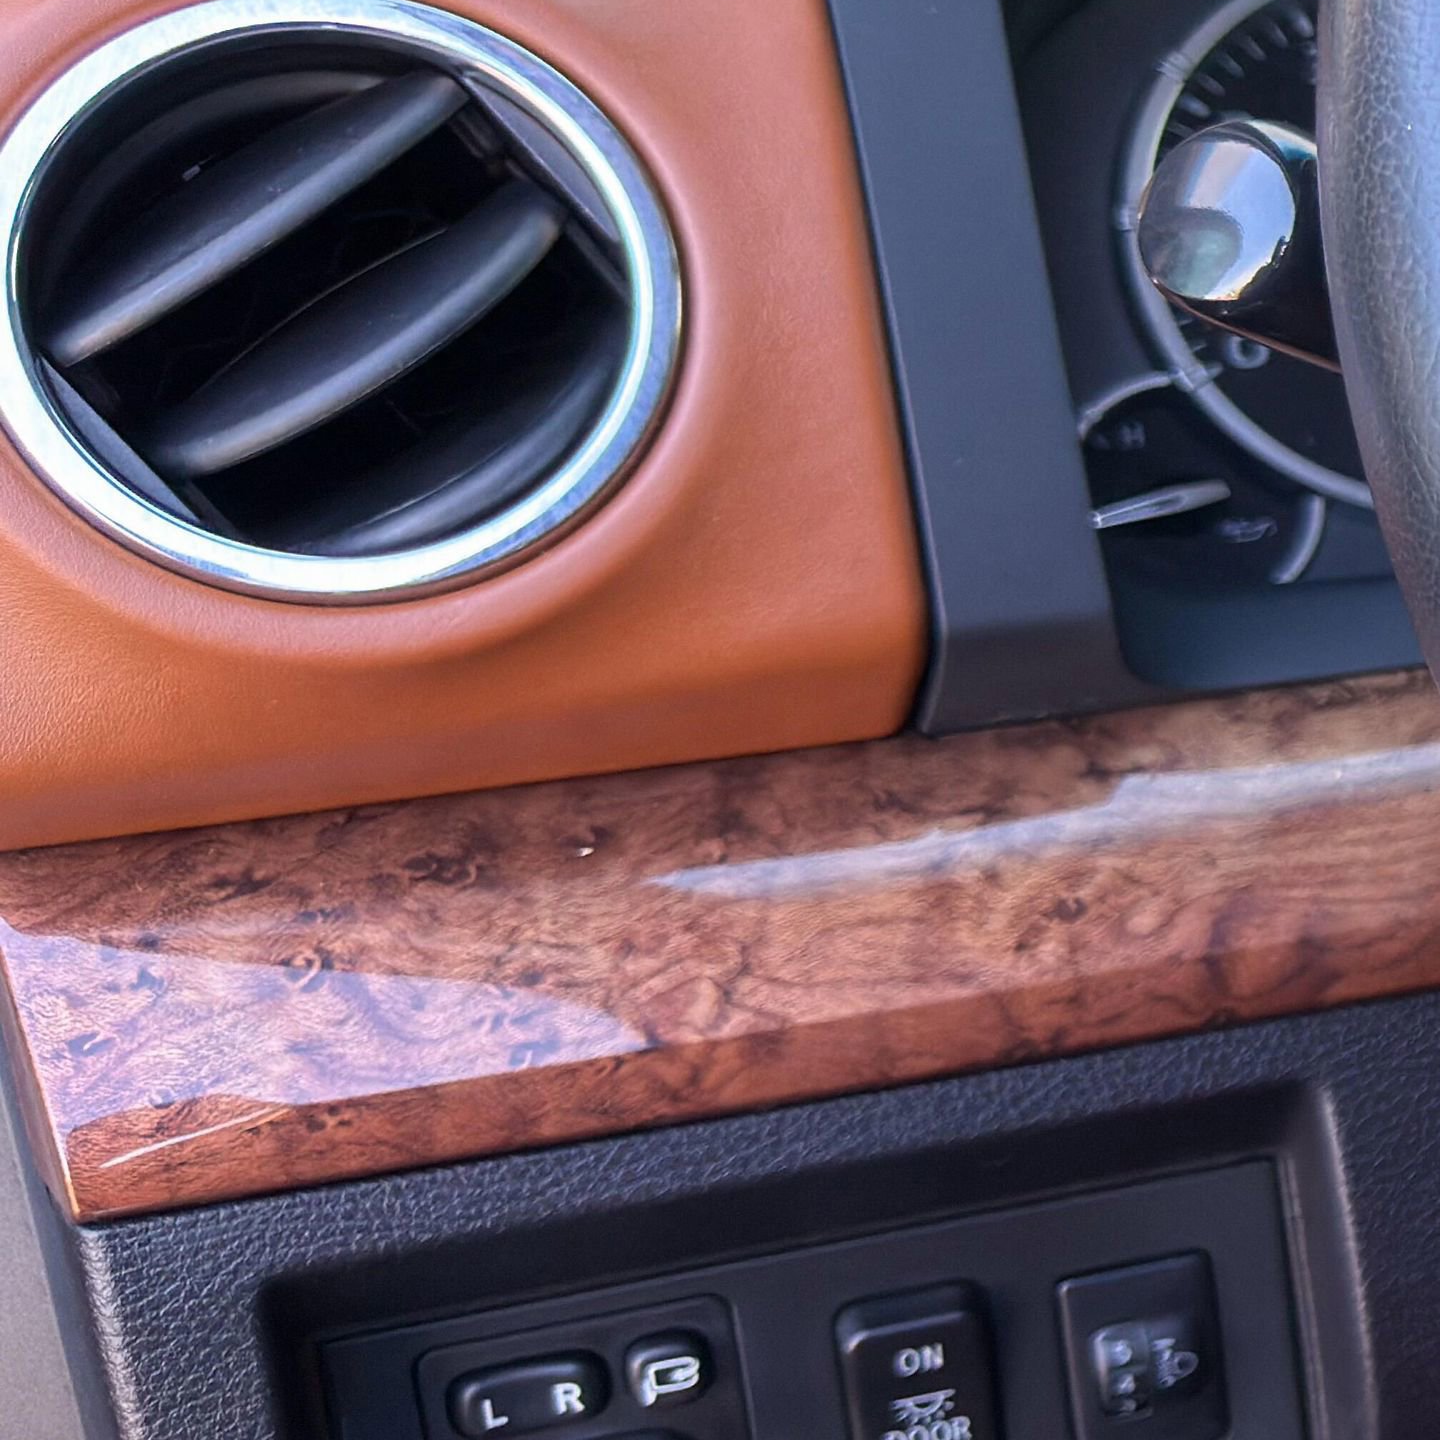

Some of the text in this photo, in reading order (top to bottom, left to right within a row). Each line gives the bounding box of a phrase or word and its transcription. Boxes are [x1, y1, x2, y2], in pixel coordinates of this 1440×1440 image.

[895, 1343, 944, 1377] ON
[482, 1382, 585, 1430] L R
